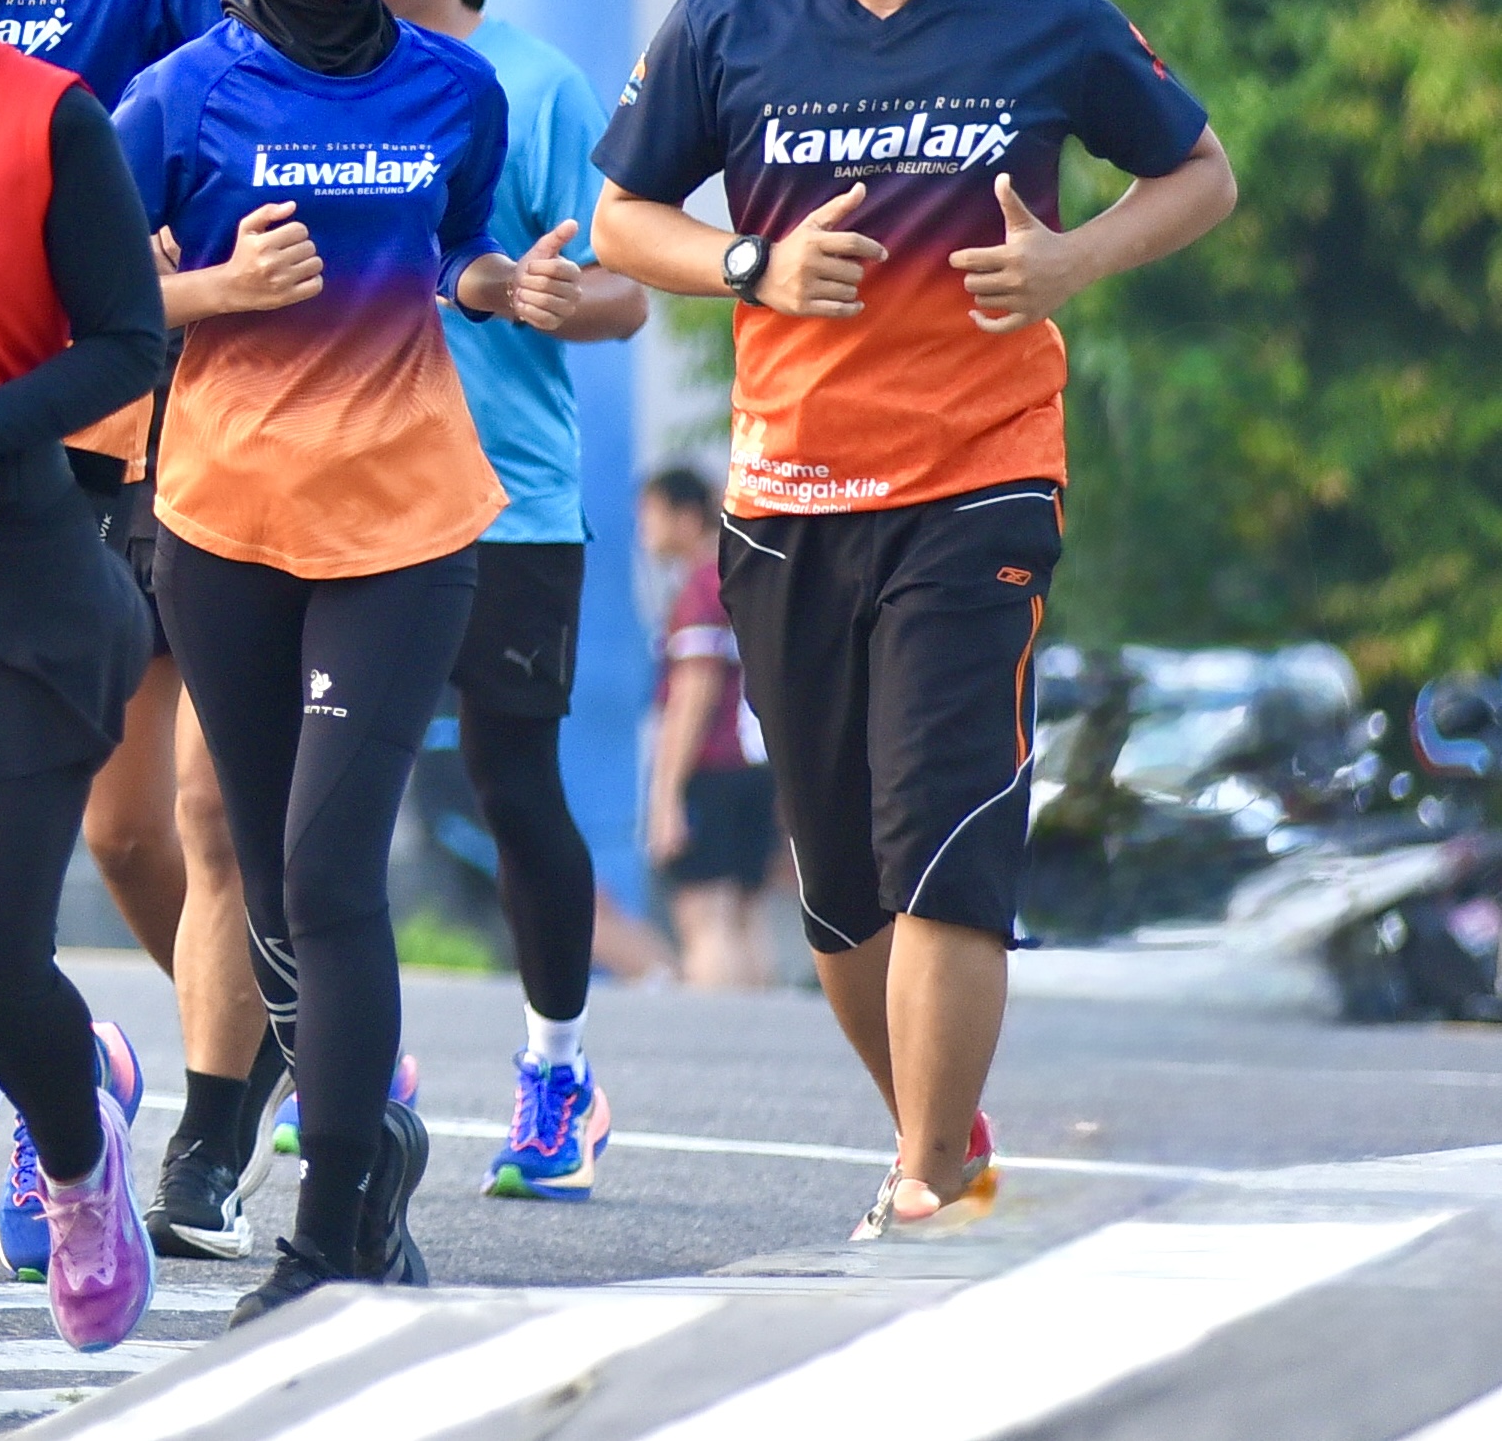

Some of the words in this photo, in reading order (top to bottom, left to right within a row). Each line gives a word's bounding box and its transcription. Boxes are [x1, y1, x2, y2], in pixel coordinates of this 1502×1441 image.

[764, 102, 850, 117] Brother
[857, 98, 928, 113] Sister
[934, 96, 1017, 109] Runner
[256, 143, 317, 152] Brother
[326, 142, 373, 151] Sister
[382, 143, 432, 151] Runner
[833, 163, 892, 178] BANGKA
[896, 161, 959, 175] BELITUNG
[314, 187, 355, 196] BANGKA
[357, 186, 404, 195] BELITUNG
[738, 468, 890, 503] Semangat-Kite
